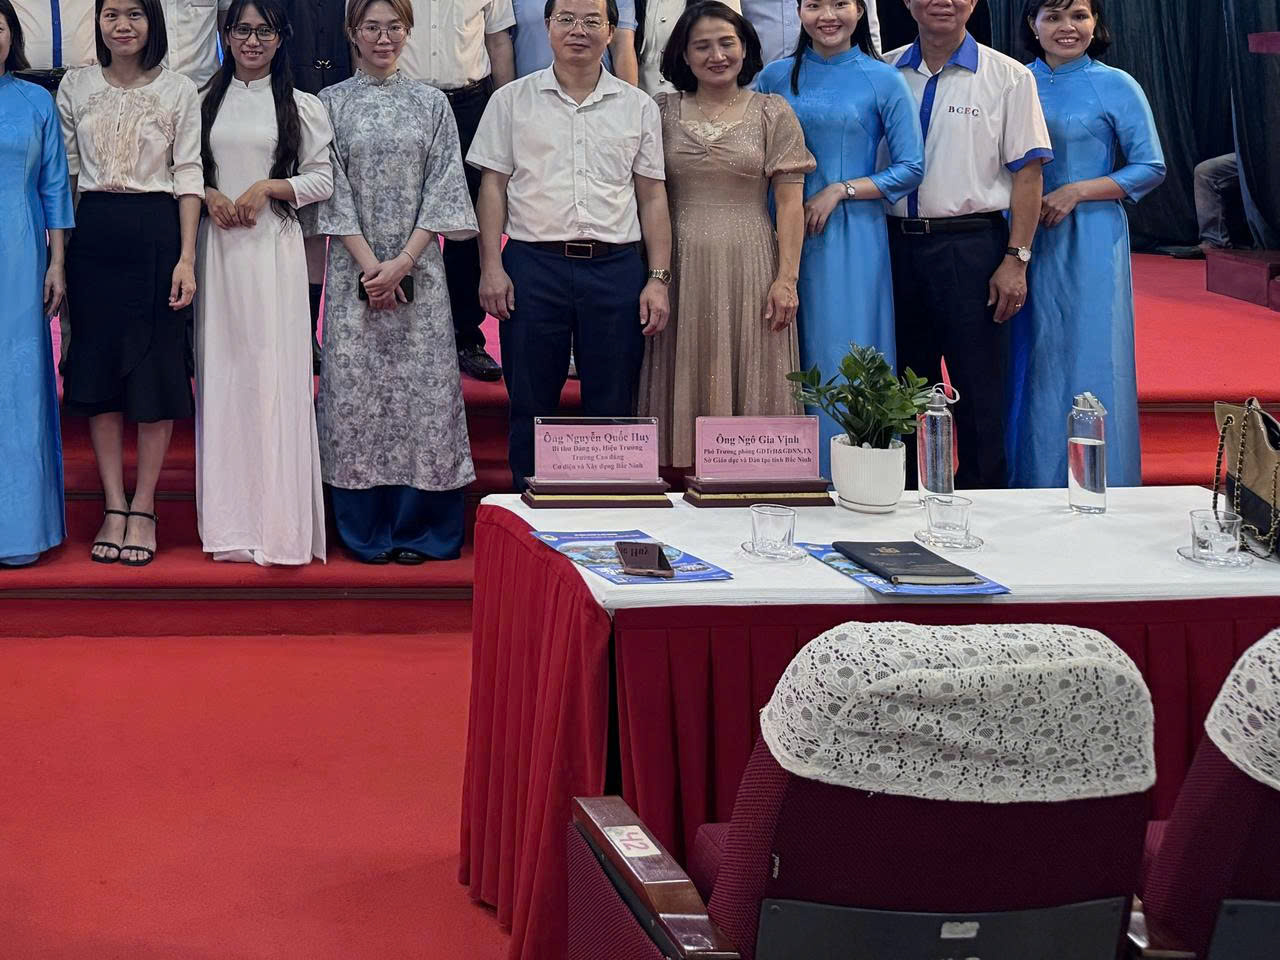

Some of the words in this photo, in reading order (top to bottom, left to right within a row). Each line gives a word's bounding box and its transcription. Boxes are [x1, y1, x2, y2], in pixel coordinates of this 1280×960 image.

[948, 105, 980, 117] BCEC
[543, 431, 564, 444] Ông
[566, 431, 601, 444] Nguyễn
[604, 430, 629, 444] Quốc
[631, 432, 650, 444] Huy
[716, 433, 735, 445] Ông
[738, 434, 756, 446] Ngô
[758, 435, 775, 444] Gia
[778, 435, 800, 446] Vịnh
